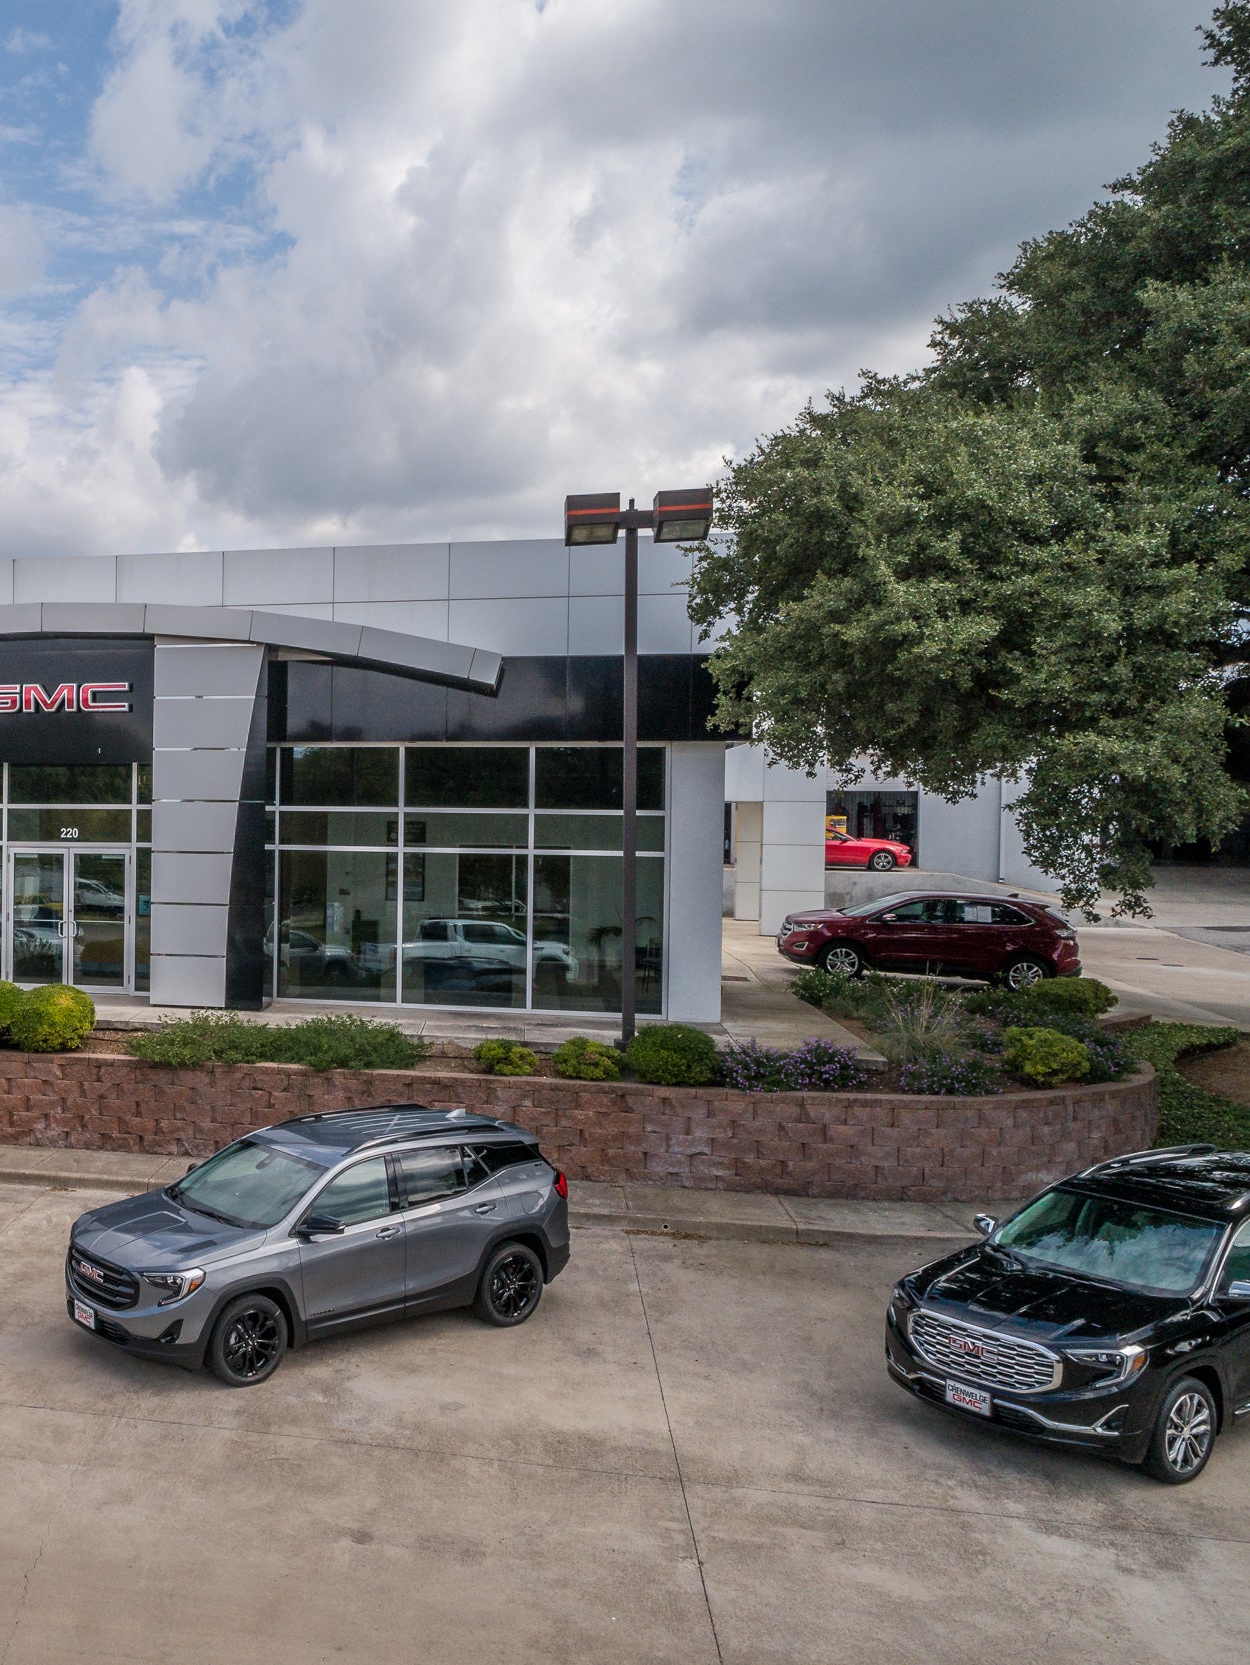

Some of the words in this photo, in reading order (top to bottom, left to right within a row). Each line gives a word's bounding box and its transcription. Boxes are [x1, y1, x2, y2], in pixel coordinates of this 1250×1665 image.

[60, 828, 79, 838] 220
[80, 1261, 104, 1284] GMC
[948, 1335, 998, 1362] GMC
[952, 1394, 983, 1410] GMC
